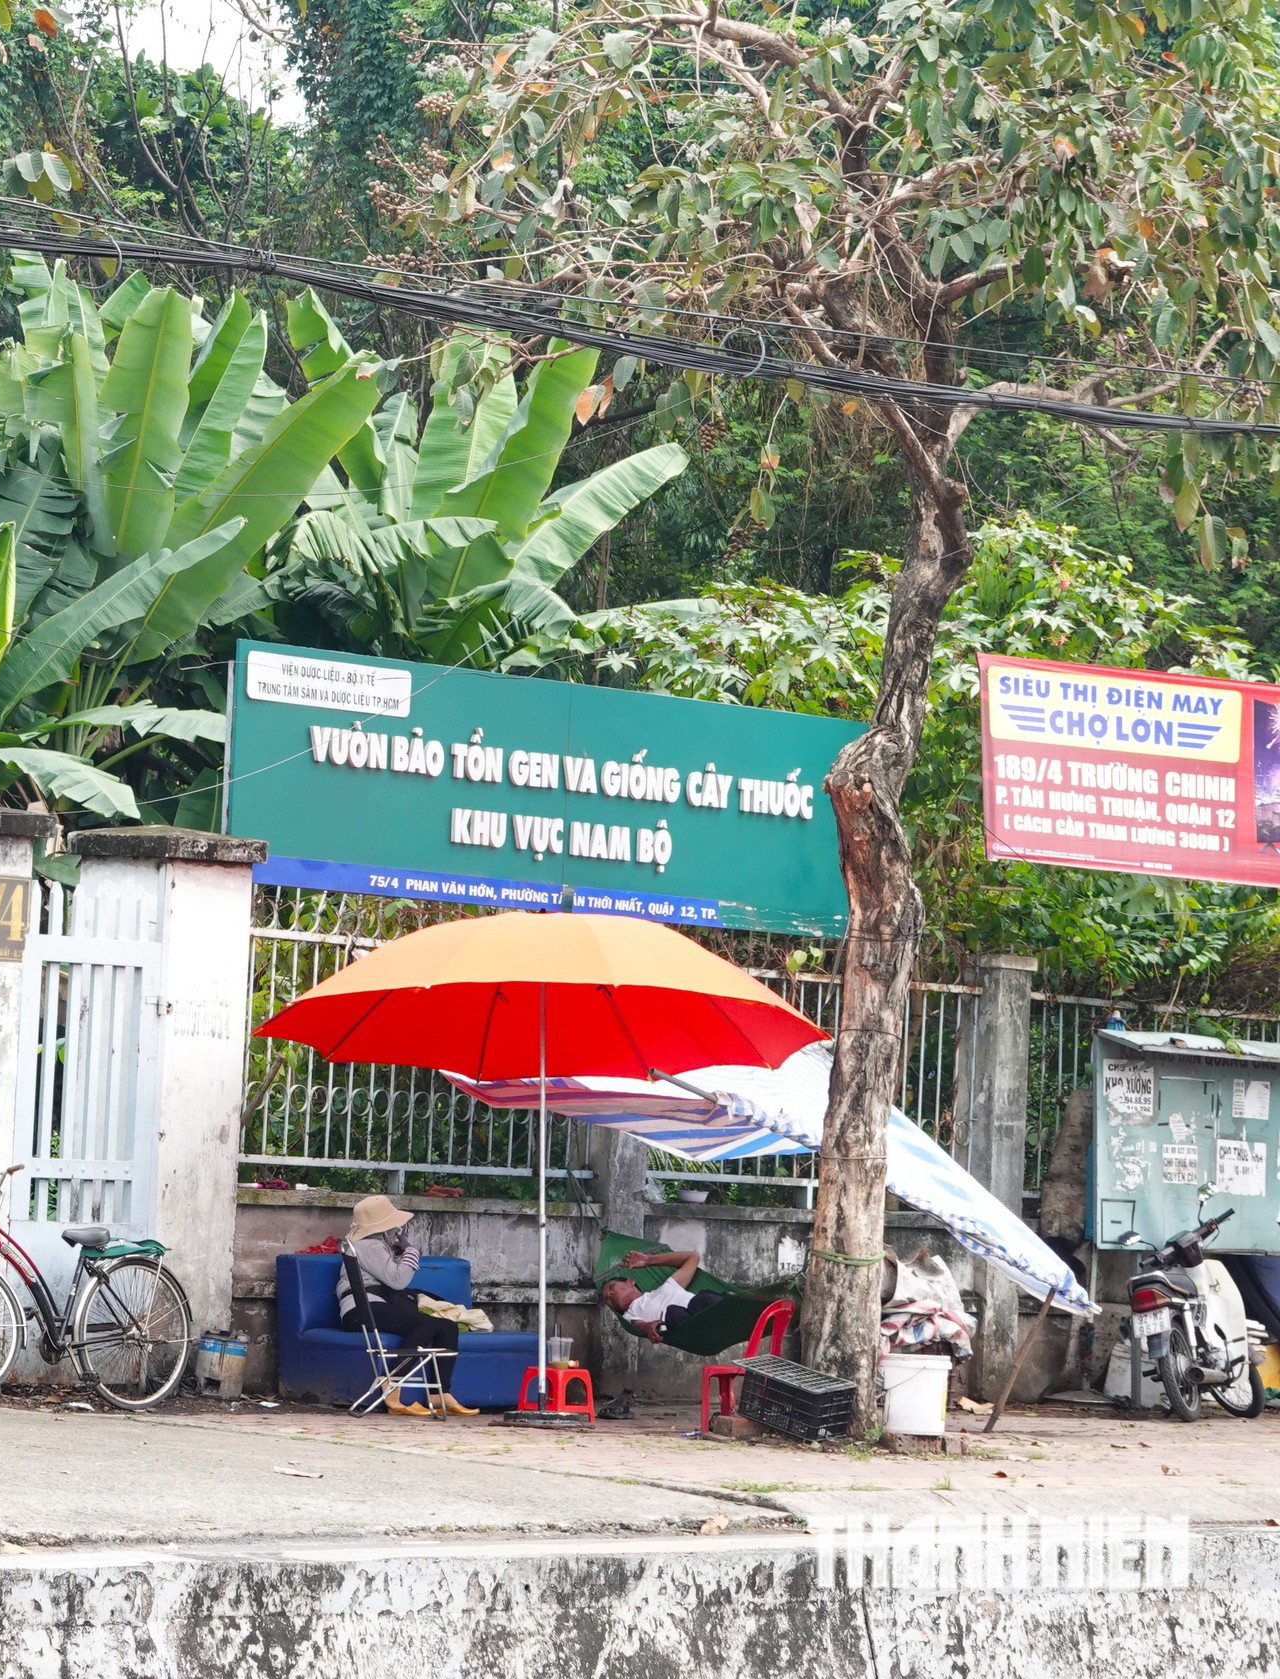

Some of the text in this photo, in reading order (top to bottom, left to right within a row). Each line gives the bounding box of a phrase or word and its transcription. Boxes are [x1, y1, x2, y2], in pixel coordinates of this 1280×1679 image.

[282, 662, 298, 676] VIỆN
[301, 665, 321, 680] DƯỢC
[323, 668, 340, 683] LIỆU
[347, 670, 357, 686] BỘ
[359, 674, 364, 684] Y
[367, 671, 377, 686] TẾ
[999, 674, 1050, 698] SIÊU
[1060, 682, 1097, 708] THỊ
[1106, 685, 1163, 713] ĐIỆN
[258, 682, 400, 710] TRUNG TÂM SÂM VÀ DƯỢC LIỆU TP.HCM
[1049, 710, 1173, 746] CHỢ LỚN
[309, 721, 388, 769] VƯỜN
[391, 727, 445, 777] BẢO
[451, 727, 503, 782] TỒN
[508, 750, 559, 789] GEN
[601, 749, 681, 803] GIỐNG
[686, 762, 733, 808] CÂY
[738, 768, 814, 820] THUỐC
[994, 754, 1236, 803] 189/4 TRƯỜNG CHINH
[1049, 790, 1096, 814] HƯNG
[1101, 796, 1161, 822] THUẬN,
[1165, 803, 1211, 828] QUẬN
[1215, 808, 1235, 829] 12
[451, 808, 672, 873] KHU VỰC NAM BỘ
[1013, 814, 1052, 834] CÁCH
[1056, 815, 1084, 838] CẦU
[1087, 822, 1127, 842] THAM
[1131, 826, 1176, 847] LƯƠNG
[1179, 831, 1220, 851] 300M
[370, 875, 399, 889] 75/4
[406, 878, 438, 893] PHAN
[441, 880, 465, 896] VĂN
[469, 883, 497, 901] HỚN,
[501, 887, 549, 904] PHƯỜNG
[588, 895, 612, 910] THỚI
[615, 897, 645, 915] NHẤT,
[681, 906, 698, 920] 12,
[701, 907, 718, 920] TP.
